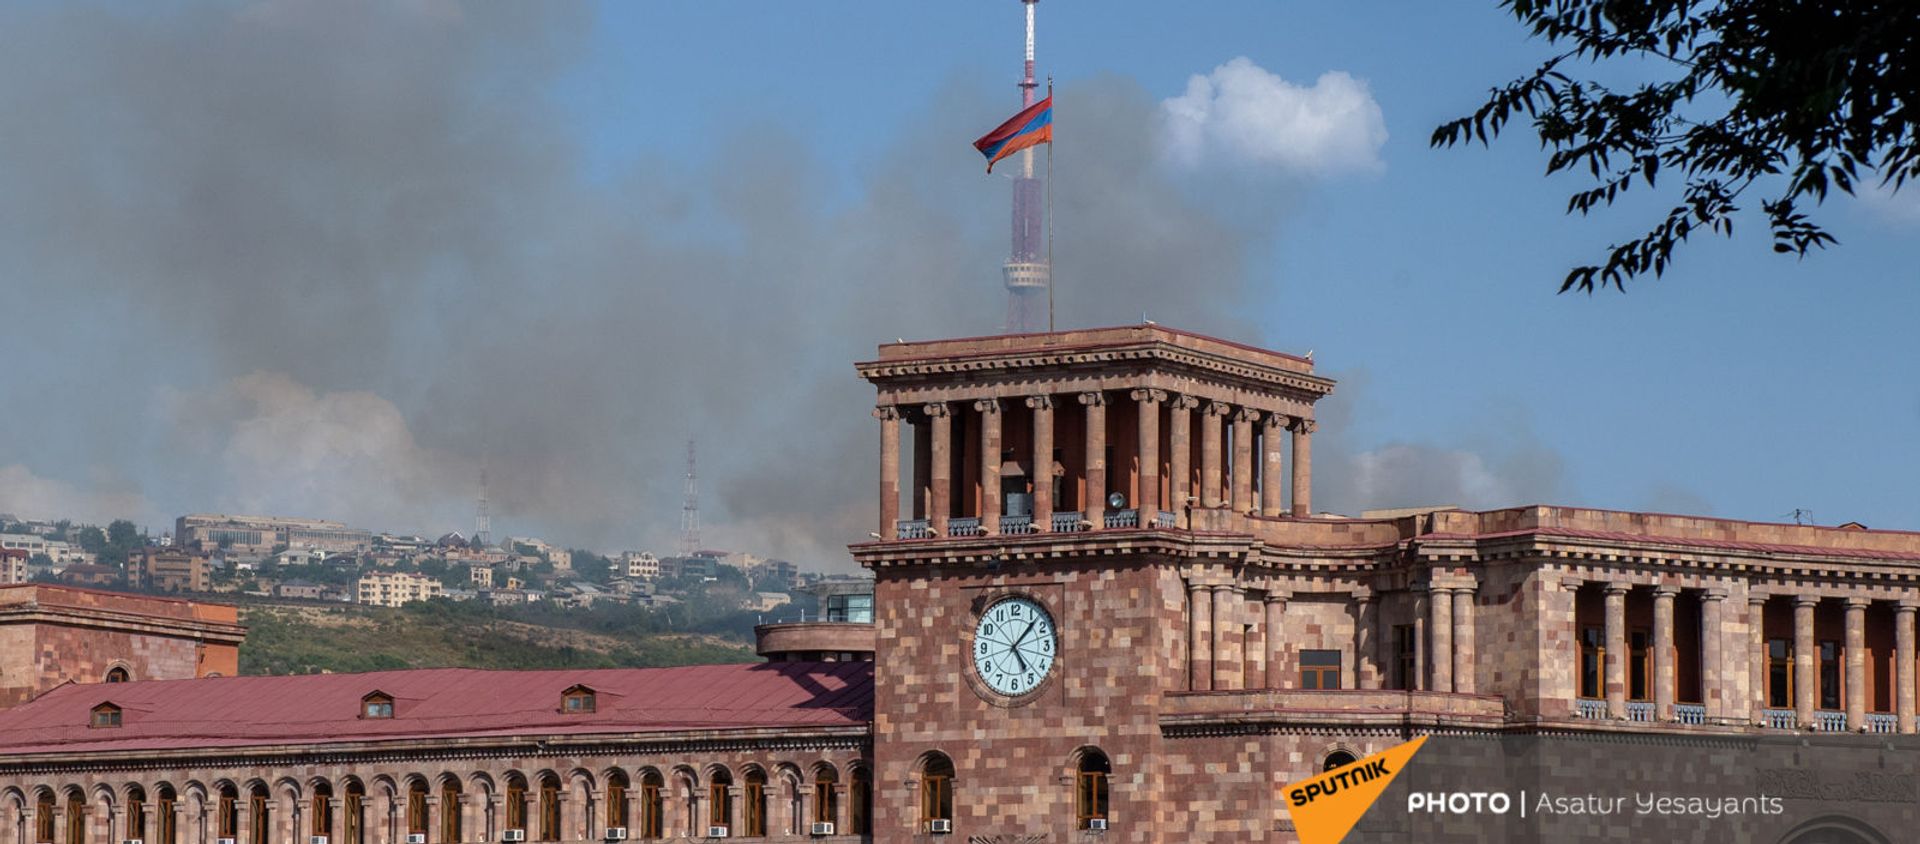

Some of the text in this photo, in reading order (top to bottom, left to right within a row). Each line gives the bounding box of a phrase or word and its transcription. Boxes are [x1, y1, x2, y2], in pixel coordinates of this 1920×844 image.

[996, 610, 1004, 622] 11
[1011, 604, 1021, 616] 12
[983, 623, 994, 636] 10
[1039, 622, 1046, 634] 2
[980, 642, 988, 654] 9
[1043, 640, 1050, 652] 3
[984, 661, 991, 673] 8
[1039, 658, 1045, 671] 4
[996, 674, 1003, 686] 7
[1011, 679, 1018, 690] 6
[1027, 673, 1034, 685] 5
